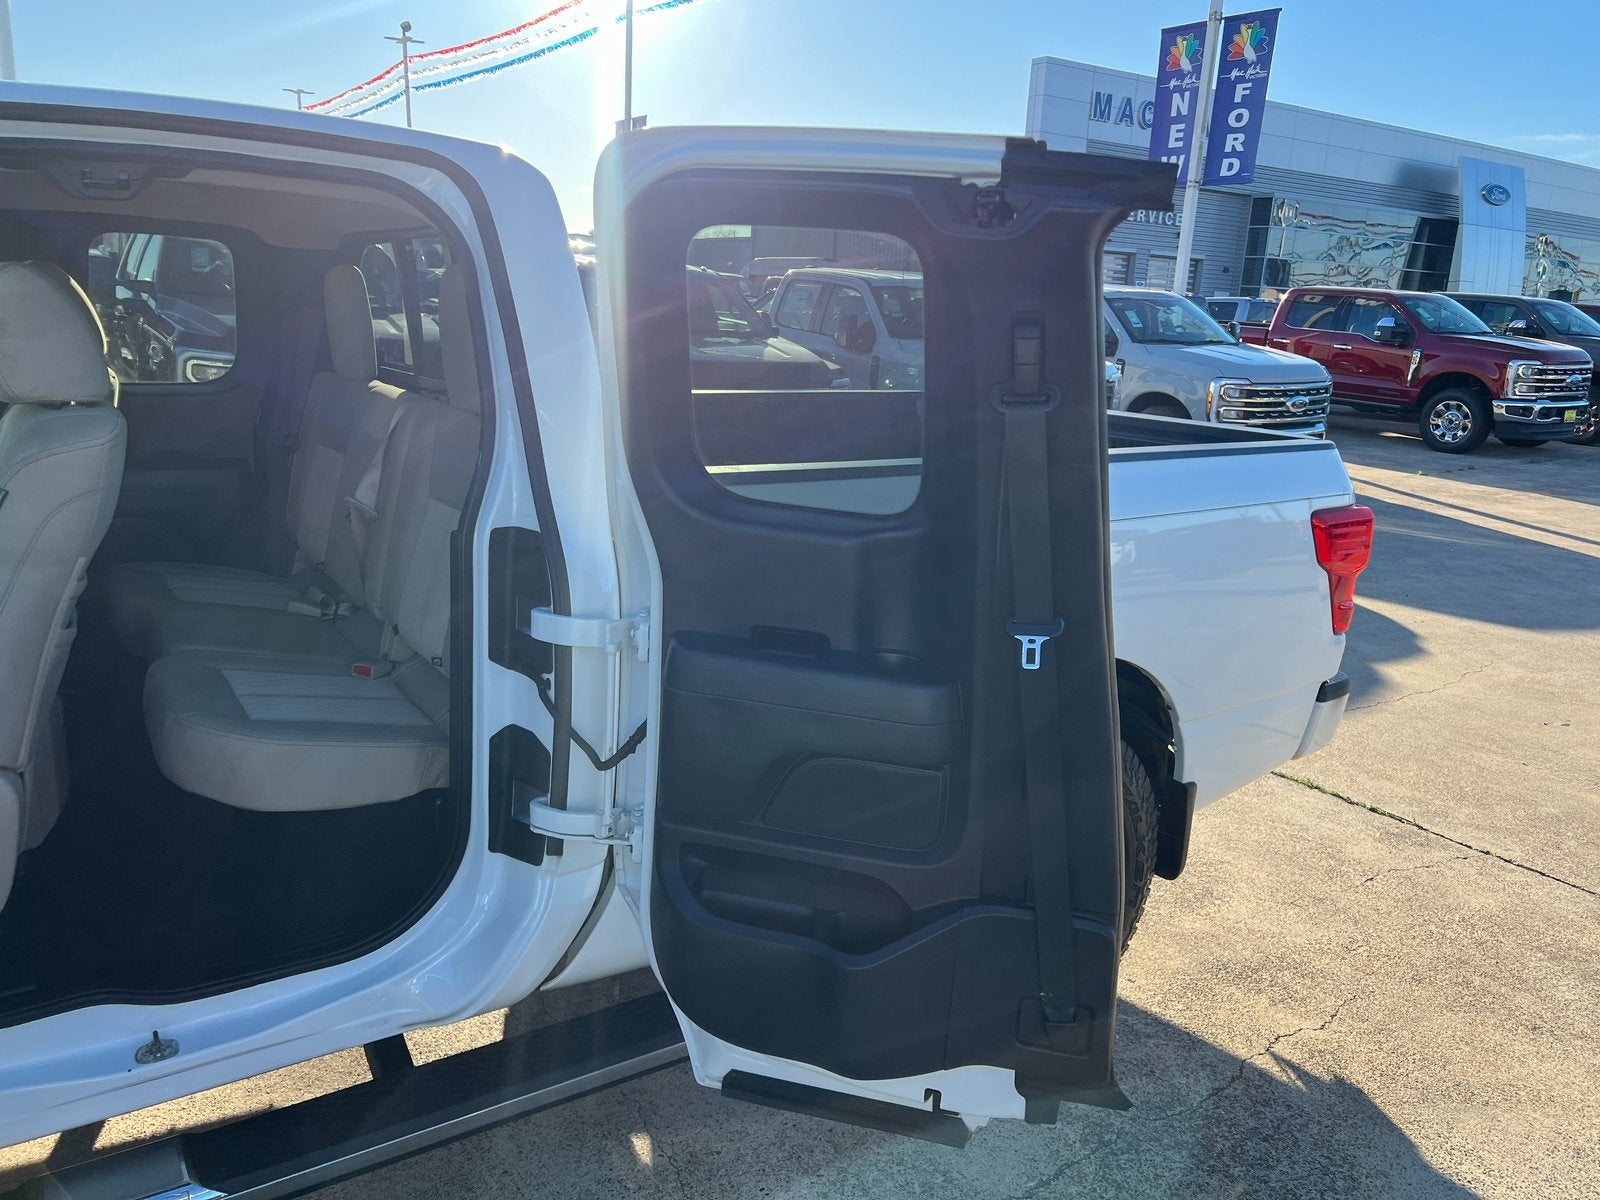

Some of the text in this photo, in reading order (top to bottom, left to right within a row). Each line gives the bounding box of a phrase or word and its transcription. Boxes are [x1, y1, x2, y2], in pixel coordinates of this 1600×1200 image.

[1090, 91, 1155, 130] MAC
[1220, 82, 1253, 177] FORD
[1126, 209, 1183, 226] ERVICE
